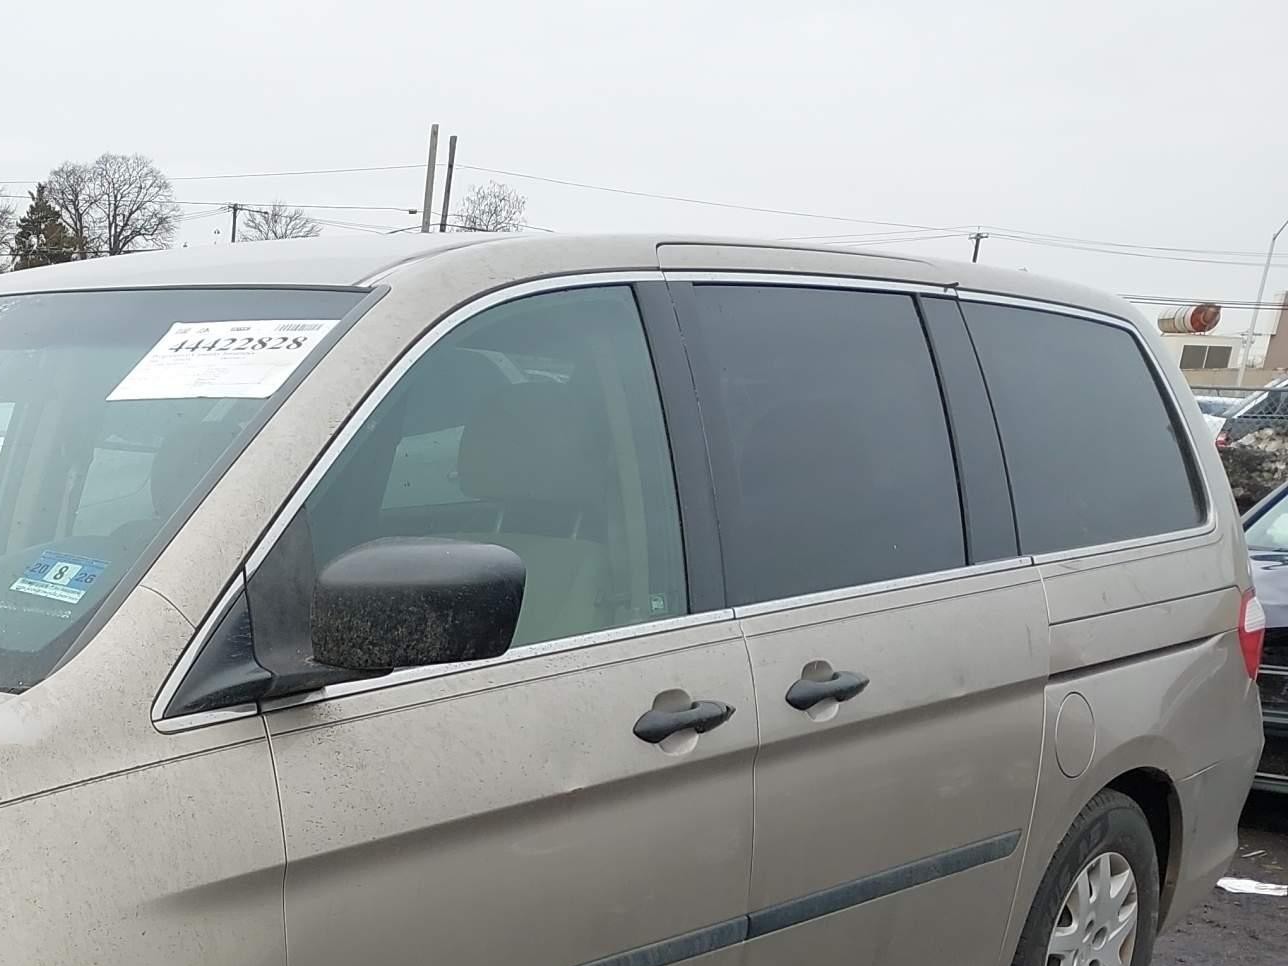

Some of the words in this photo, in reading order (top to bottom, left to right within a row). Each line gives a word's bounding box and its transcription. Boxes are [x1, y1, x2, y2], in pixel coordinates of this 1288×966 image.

[168, 335, 309, 353] 44422828
[30, 562, 50, 574] 20
[53, 565, 69, 580] 8
[75, 572, 97, 584] 26
